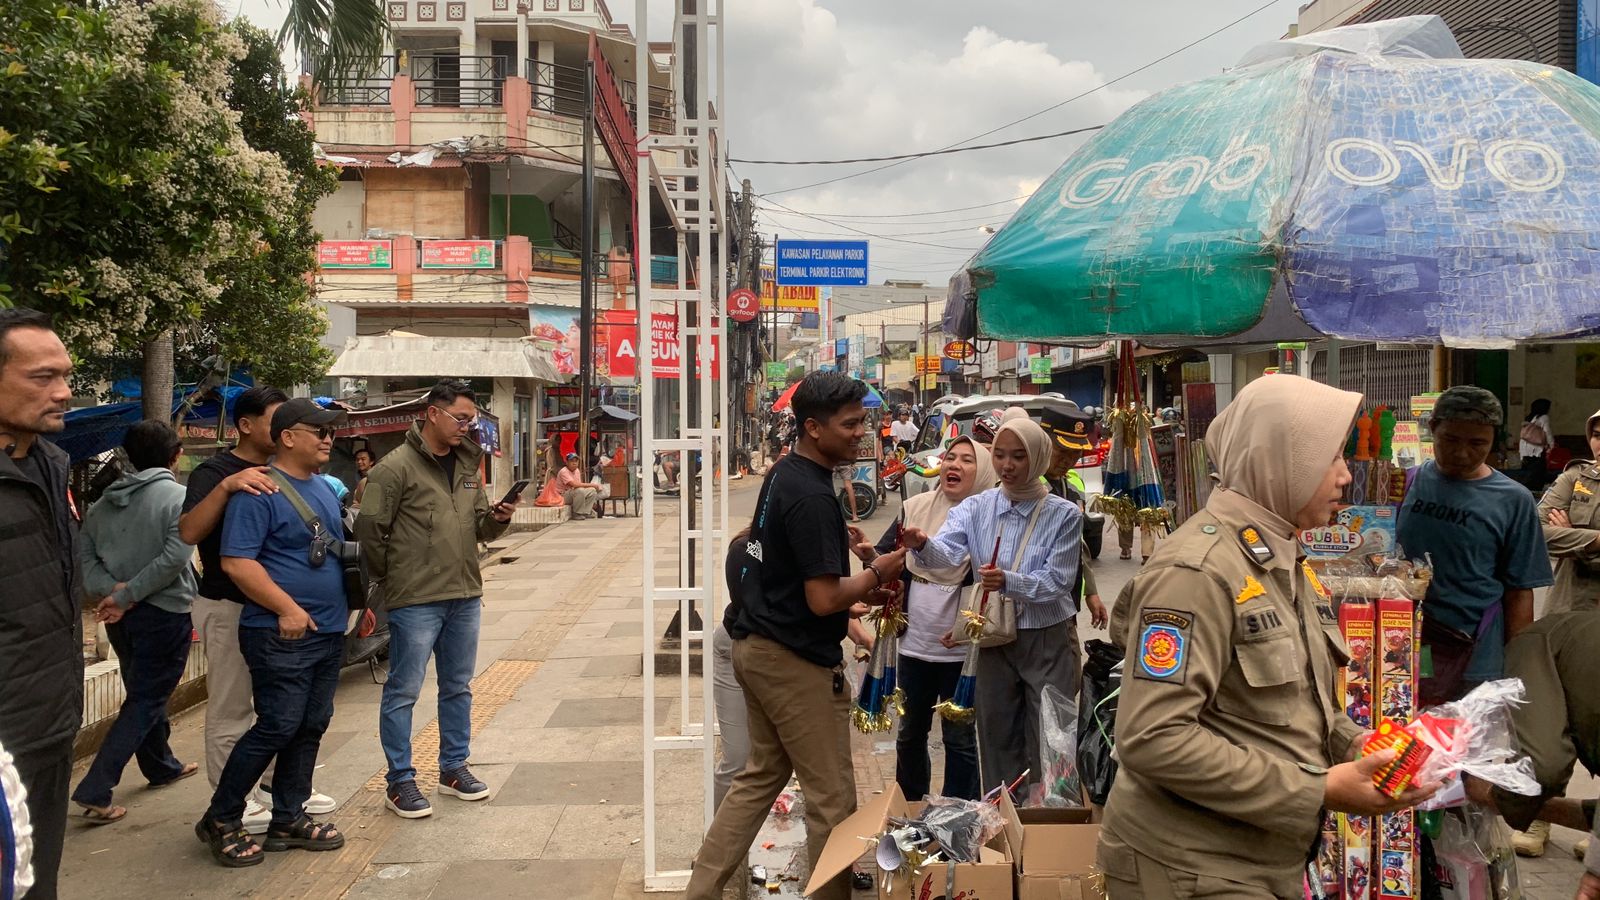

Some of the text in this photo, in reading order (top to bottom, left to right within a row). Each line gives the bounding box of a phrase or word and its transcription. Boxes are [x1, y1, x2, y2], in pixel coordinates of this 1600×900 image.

[1325, 138, 1565, 192] OVO
[1059, 138, 1271, 209] Grab
[782, 248, 864, 260] KAWASAN PELAYANAN PARKIR
[780, 266, 866, 278] TERMINAL PARKIR ELEKTRONIK
[783, 286, 816, 300] ABADI
[652, 320, 674, 330] AYAM
[364, 414, 420, 428] SEDUHAN
[1411, 498, 1472, 527] BRONX
[1305, 531, 1356, 544] BUBBLE
